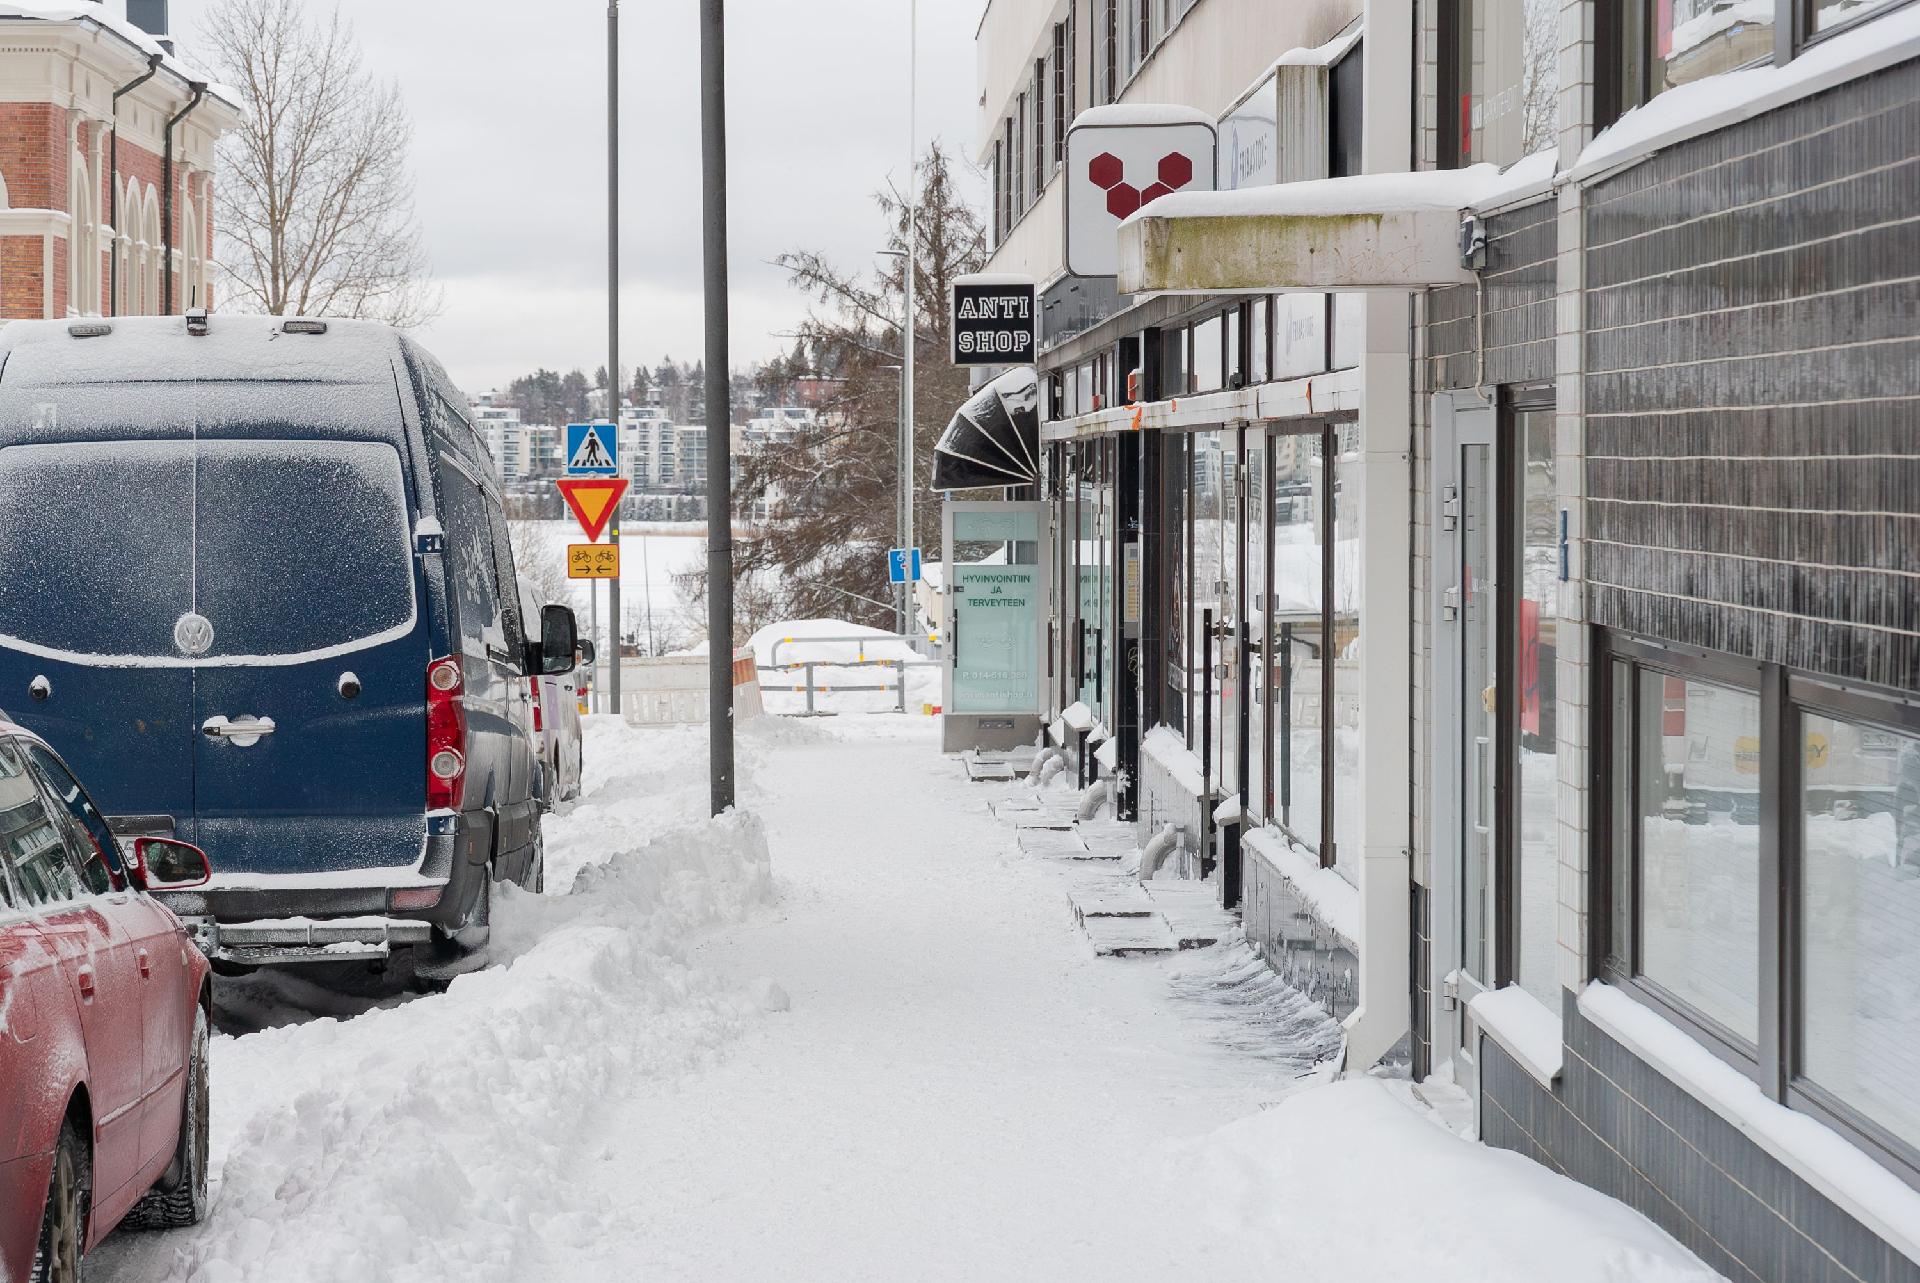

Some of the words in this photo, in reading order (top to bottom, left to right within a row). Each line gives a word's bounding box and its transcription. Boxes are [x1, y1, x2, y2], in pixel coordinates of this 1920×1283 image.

[958, 296, 1029, 319] ANTI
[958, 330, 1031, 353] SHOP
[962, 574, 1031, 583] HYVINVOINTIIN
[991, 586, 1002, 594] JA
[968, 598, 1025, 607] TERVEYTEEN
